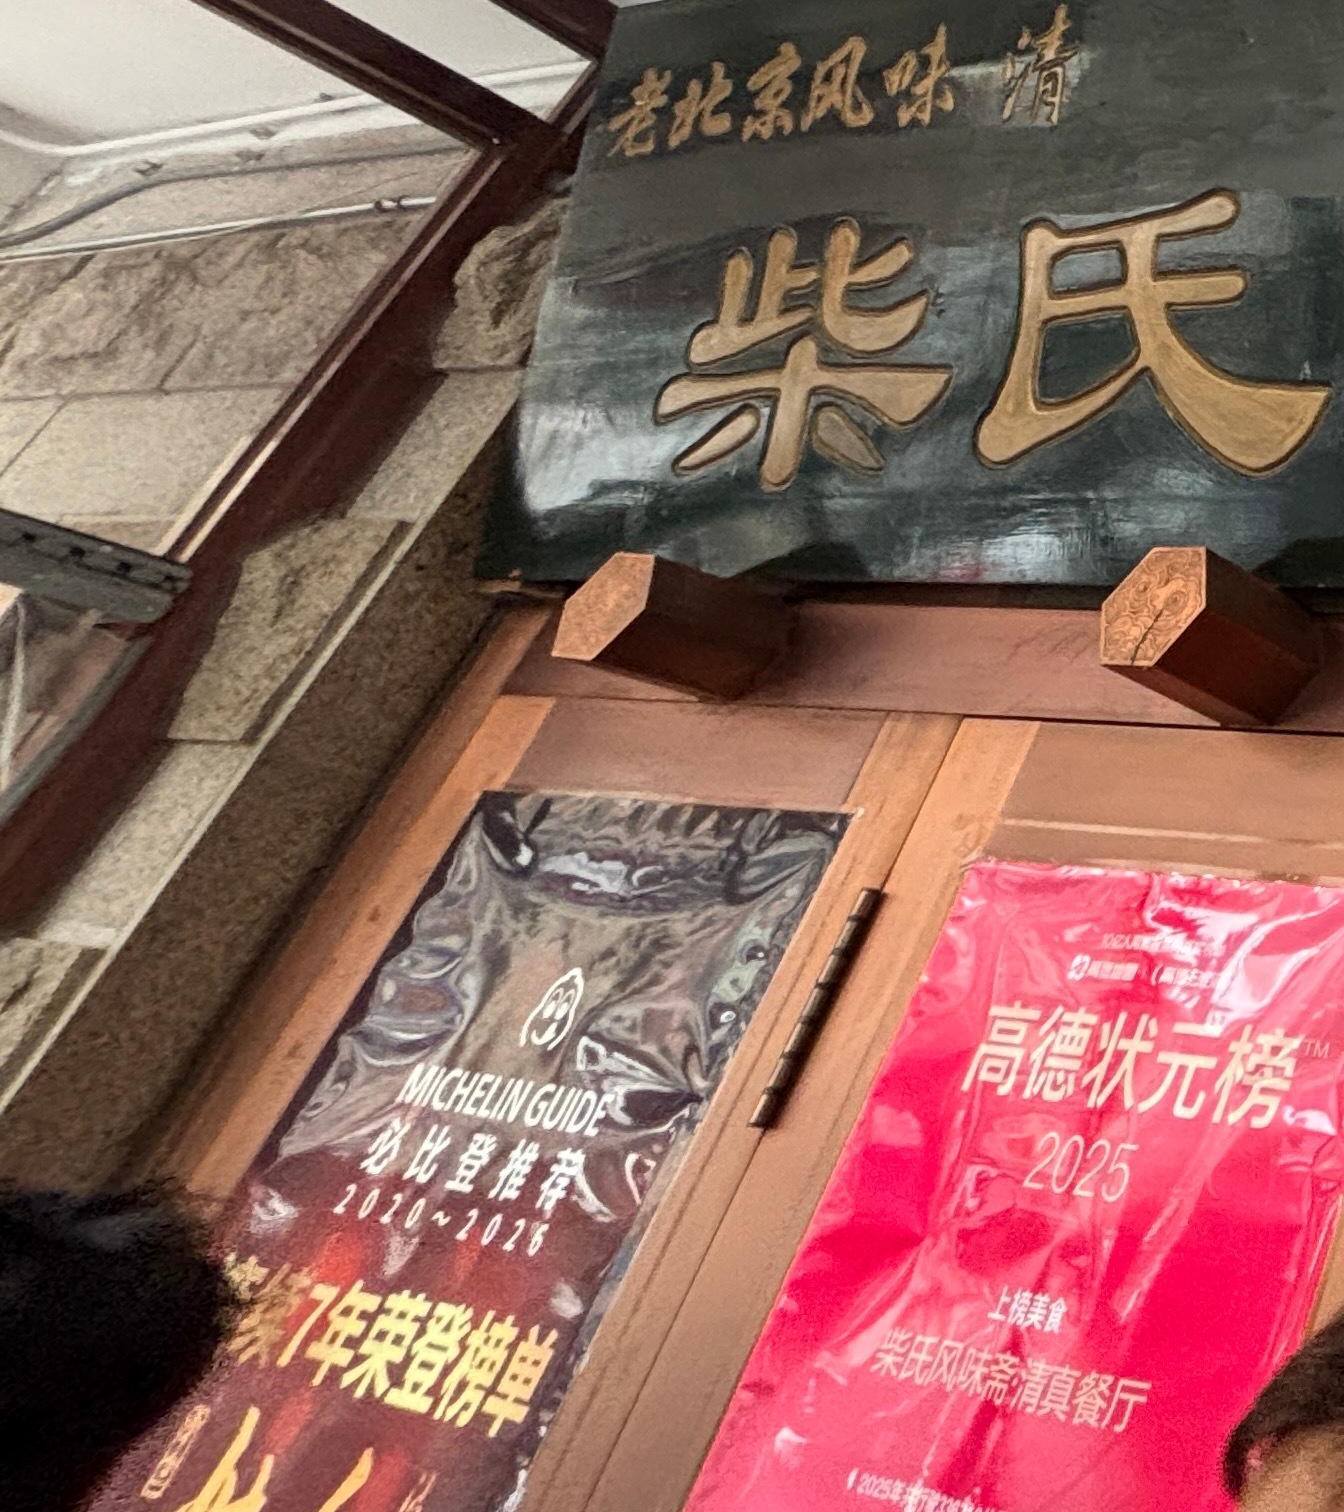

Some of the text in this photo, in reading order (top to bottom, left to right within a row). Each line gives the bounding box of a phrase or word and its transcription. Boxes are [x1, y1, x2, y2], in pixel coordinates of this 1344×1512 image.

[608, 24, 956, 158] 老北京风味
[1001, 2, 1080, 126] 清
[396, 1062, 616, 1137] MICHELIN GUIDE
[960, 1000, 1305, 1129] 高德状元榜
[360, 1116, 586, 1219] 必比登推荐
[1022, 1131, 1140, 1202] 2025
[987, 1285, 1068, 1334] 上榜美食
[870, 1329, 1153, 1433] 柴氏风味斋清真餐厅
